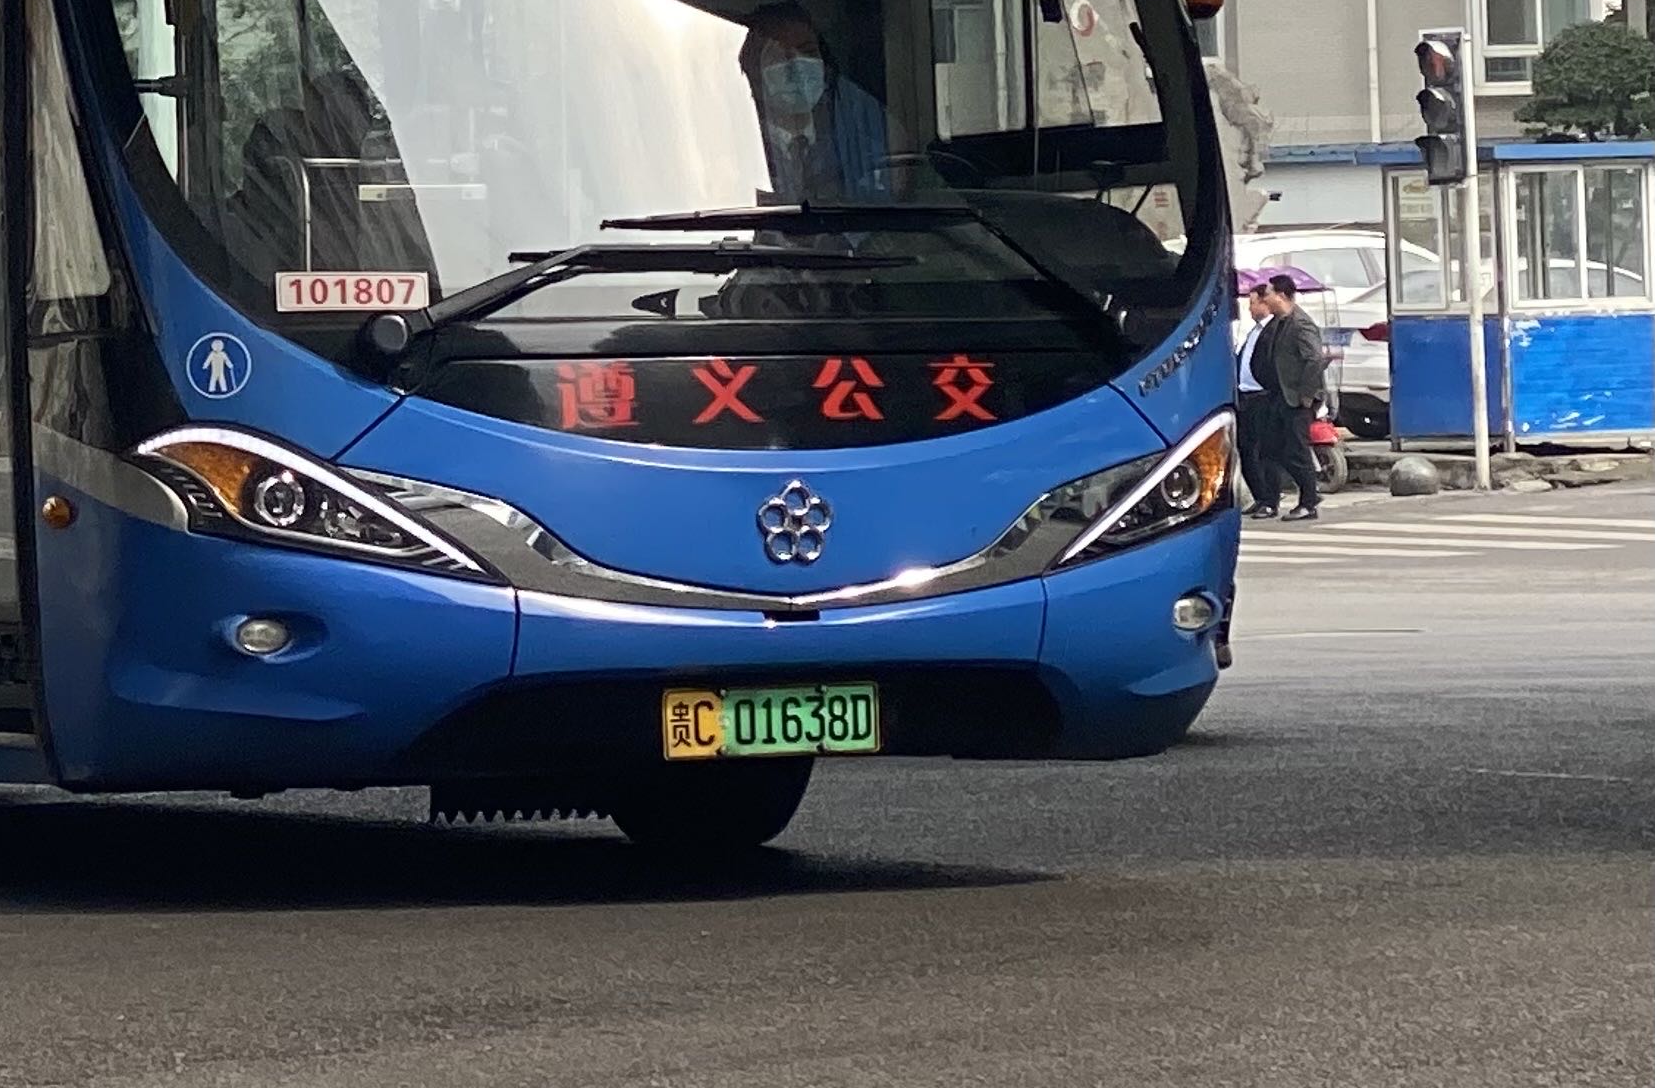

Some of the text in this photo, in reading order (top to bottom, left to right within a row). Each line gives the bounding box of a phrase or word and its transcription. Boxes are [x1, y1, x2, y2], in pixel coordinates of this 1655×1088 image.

[288, 278, 416, 305] 101807
[556, 355, 998, 430] 遵义公交
